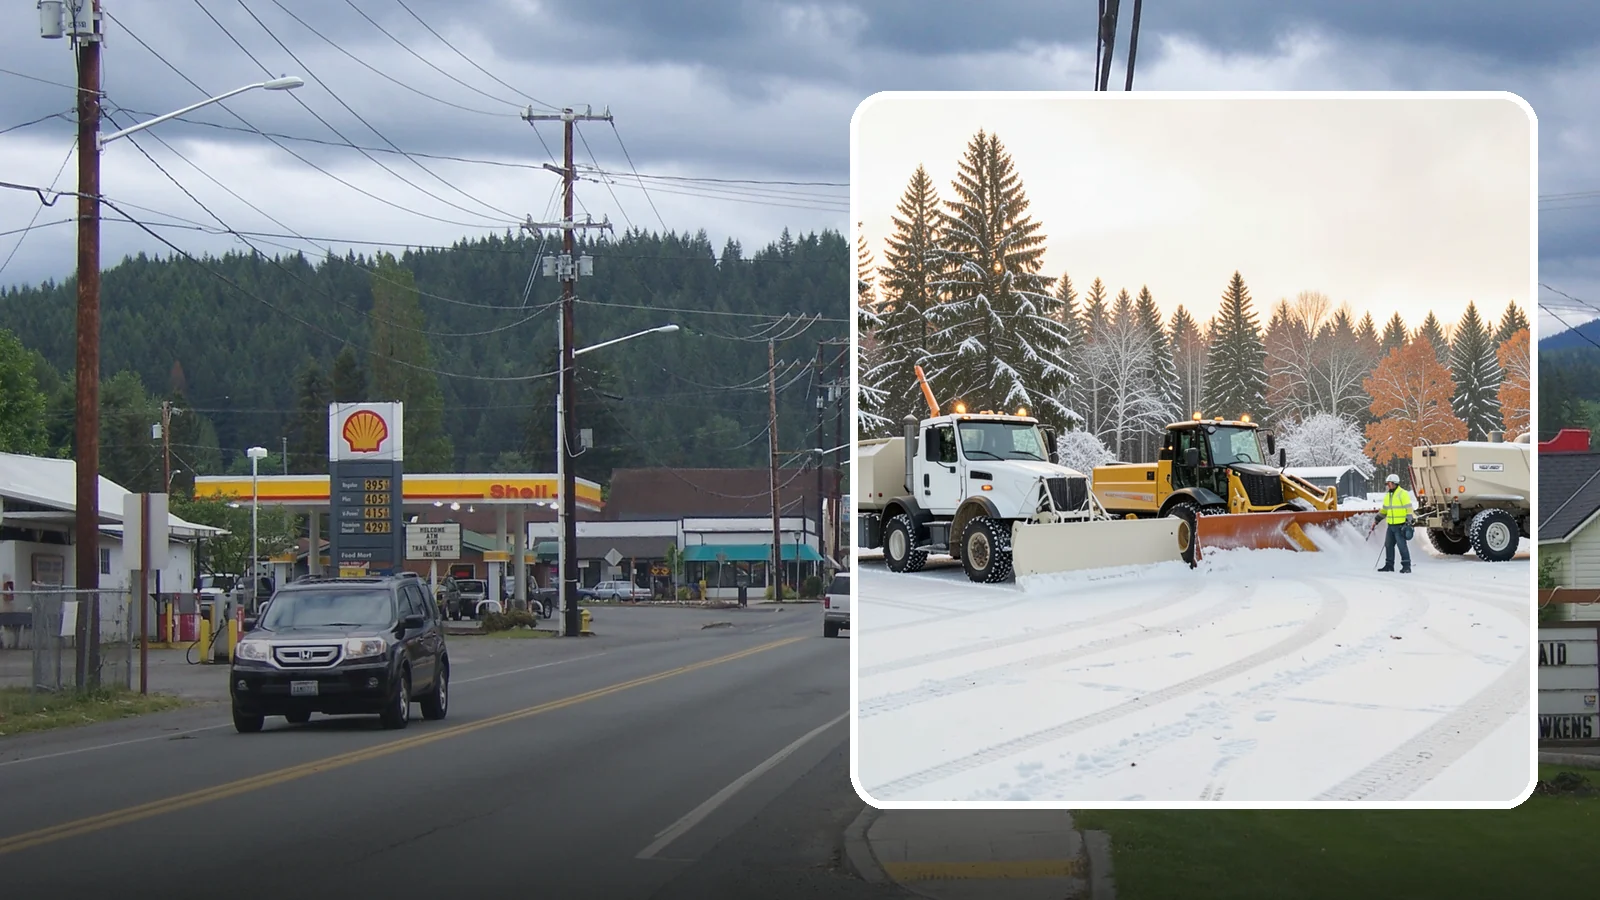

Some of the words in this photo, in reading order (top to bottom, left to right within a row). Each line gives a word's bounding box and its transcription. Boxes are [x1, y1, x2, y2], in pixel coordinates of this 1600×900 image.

[366, 480, 383, 490] 395
[490, 484, 547, 499] Shell
[366, 494, 383, 504] 405
[365, 508, 383, 518] 415
[366, 522, 383, 532] 429
[1539, 643, 1566, 665] AID
[1539, 716, 1592, 739] WKENS
